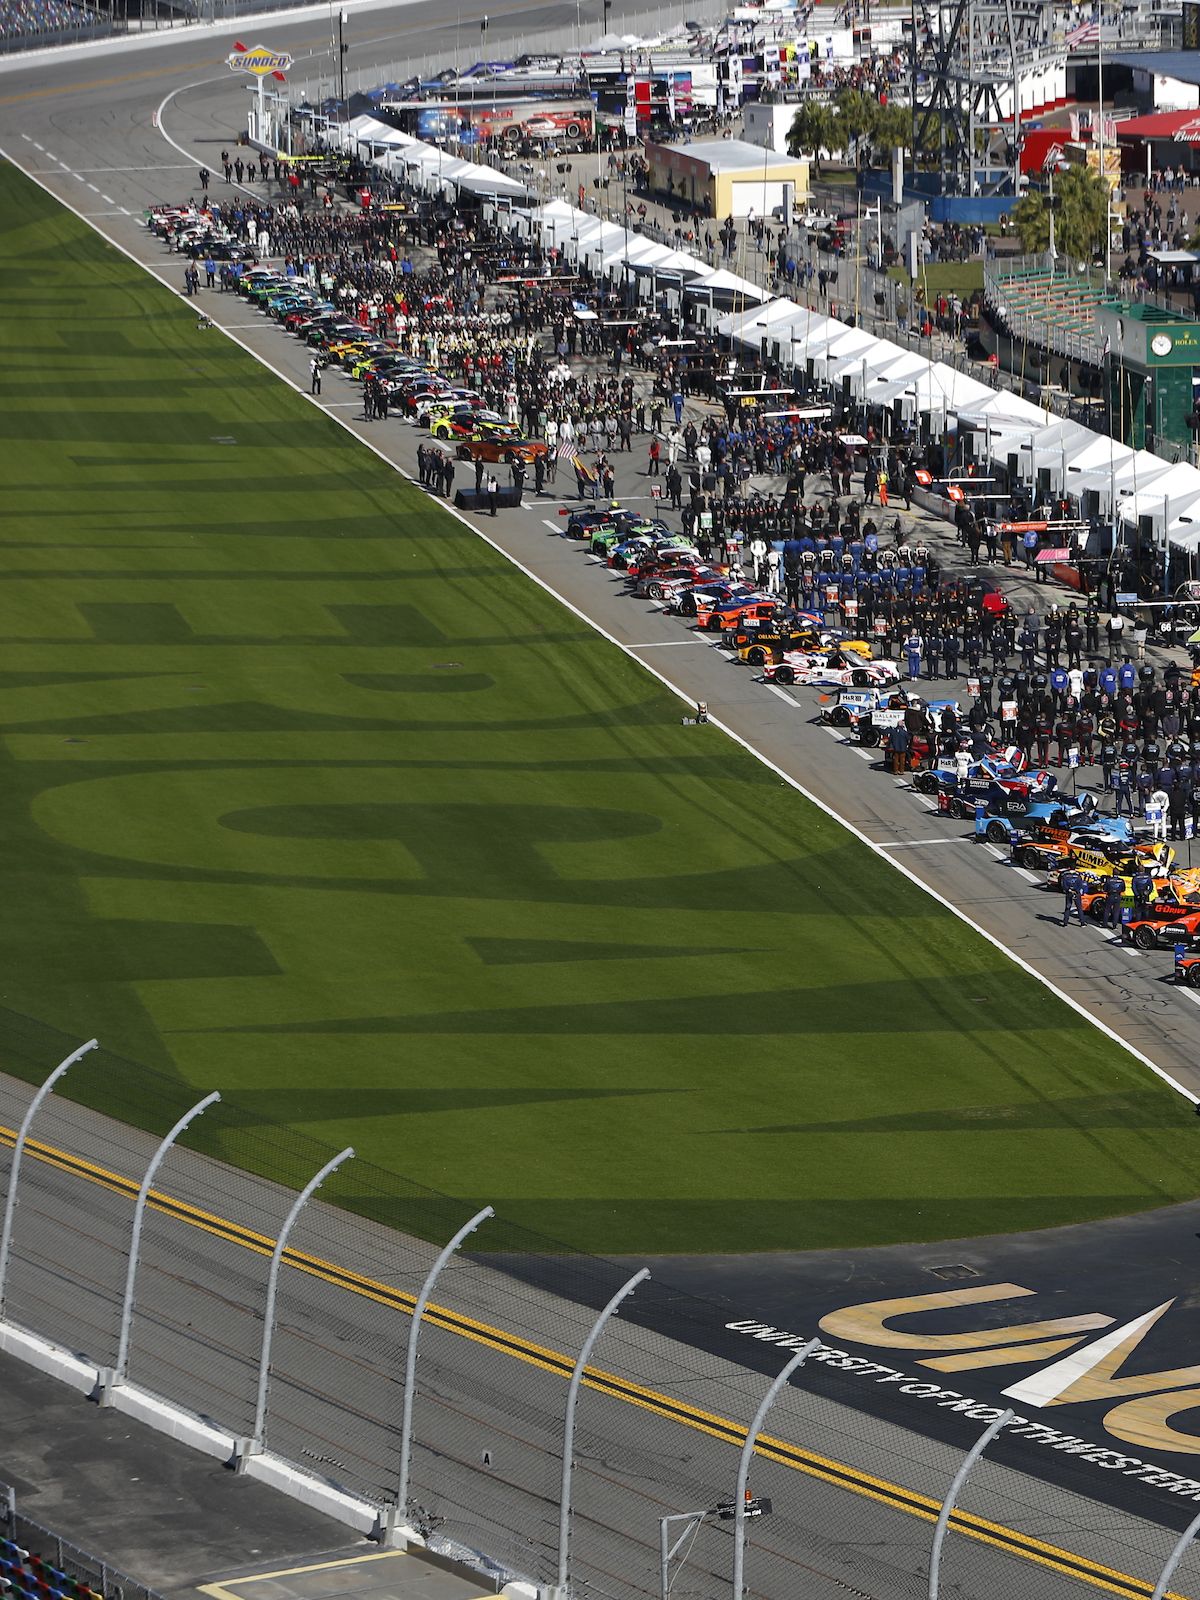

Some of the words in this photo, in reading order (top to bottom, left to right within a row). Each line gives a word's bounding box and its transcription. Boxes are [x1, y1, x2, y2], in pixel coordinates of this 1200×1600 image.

[233, 57, 287, 67] SUNOCO
[1174, 338, 1199, 347] ROLEX
[1160, 623, 1172, 632] 66
[1006, 801, 1027, 809] ERA
[899, 1383, 963, 1400] OF
